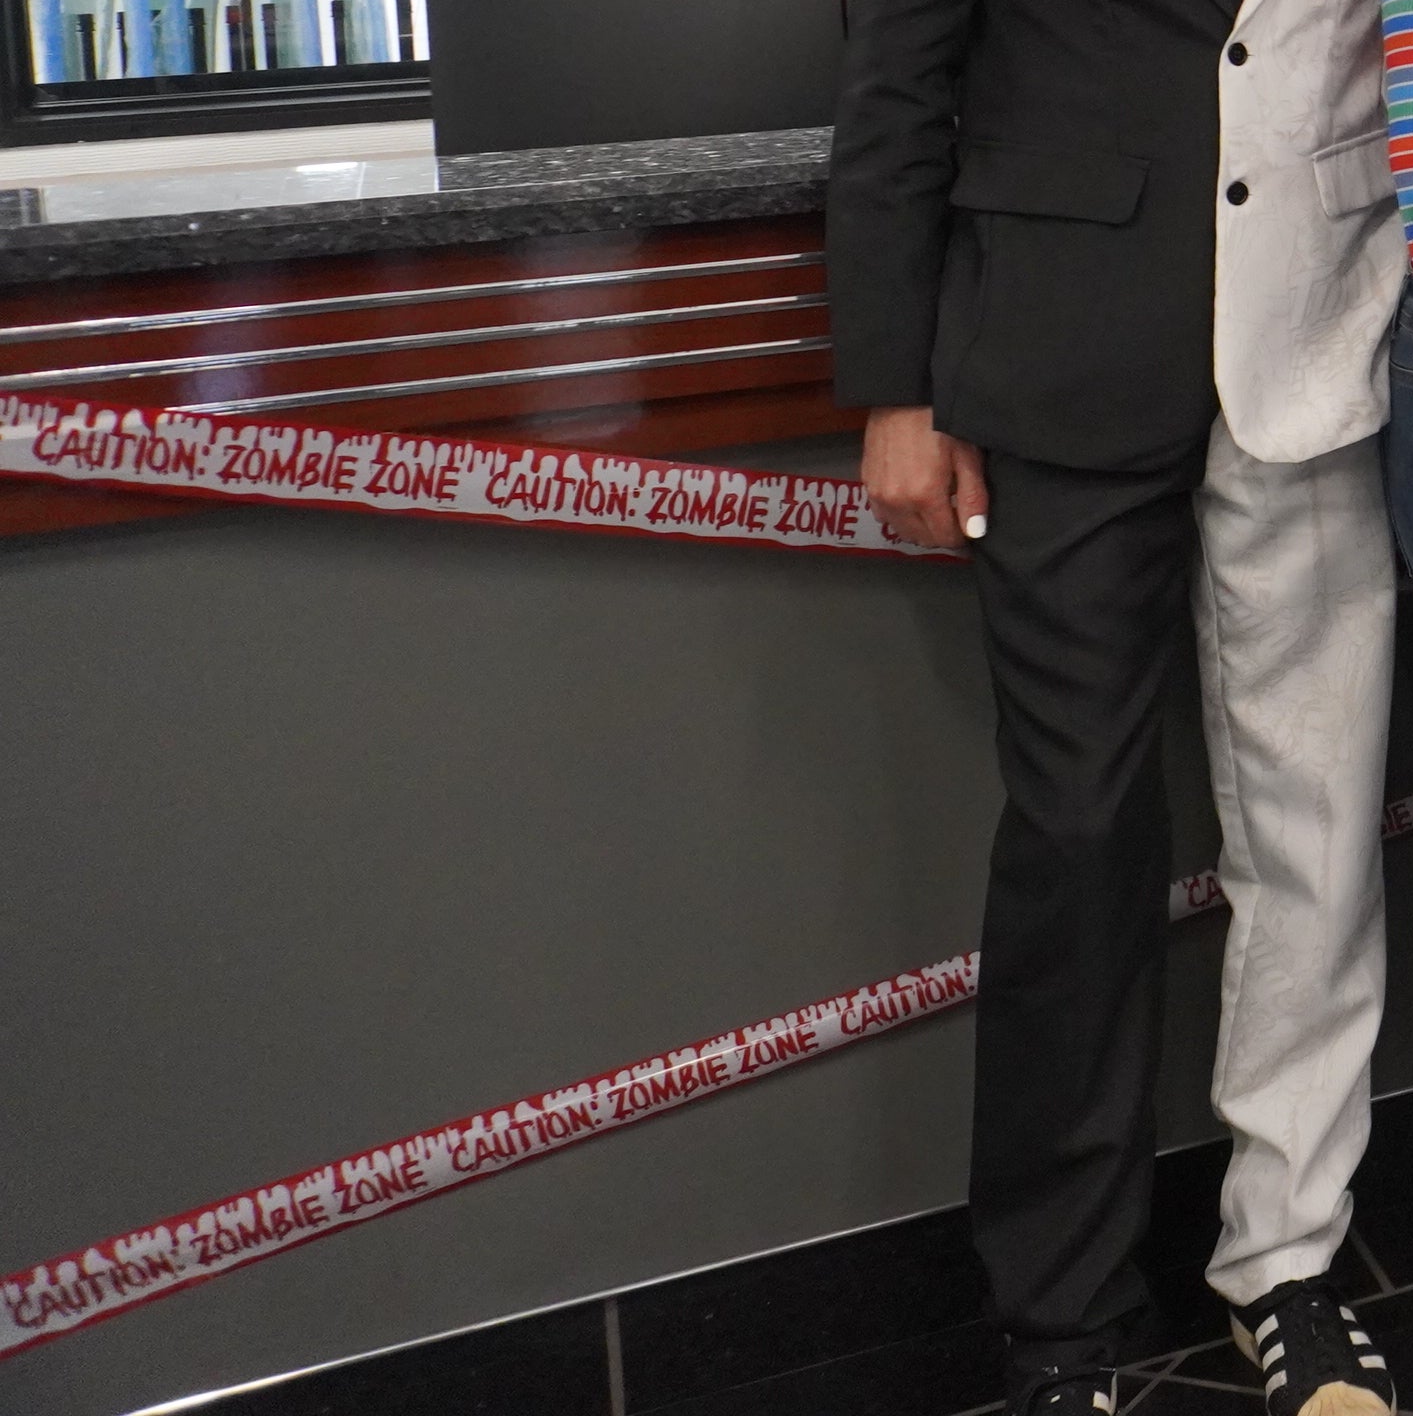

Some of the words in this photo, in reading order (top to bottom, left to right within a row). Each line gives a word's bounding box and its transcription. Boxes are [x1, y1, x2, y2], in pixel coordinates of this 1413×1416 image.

[33, 425, 209, 481] CAUTION:
[217, 444, 357, 494] ZOMBIE
[364, 460, 460, 503] ZONE
[486, 470, 640, 522] CAUTION:
[645, 486, 770, 534] ZOMBIE
[774, 498, 858, 540] ZONE
[7, 1246, 185, 1329] CAUTION:
[190, 1194, 329, 1265] ZOMBIE
[337, 1159, 428, 1215] ZONE
[452, 1094, 603, 1172] CAUTION:
[607, 1054, 731, 1121] ZOMBIE
[735, 1021, 819, 1074] ZONE
[841, 962, 976, 1036] CAUTION:
